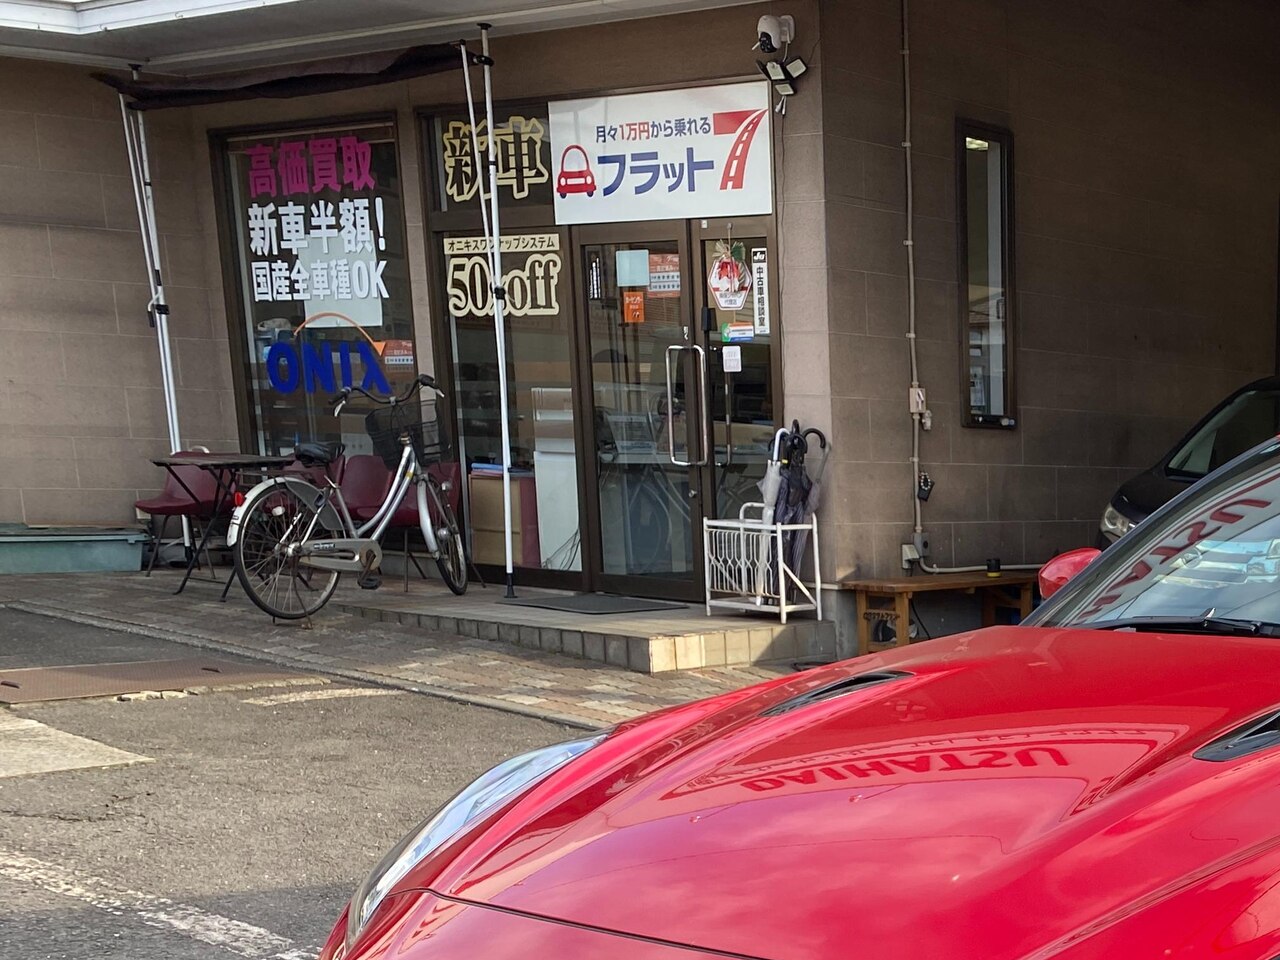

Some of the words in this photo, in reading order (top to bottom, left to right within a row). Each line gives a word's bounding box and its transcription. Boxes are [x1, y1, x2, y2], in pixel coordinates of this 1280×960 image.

[596, 118, 711, 143] 月々1万円から乗れる
[246, 137, 375, 198] 高価買取
[248, 197, 386, 256] 新車半額!
[250, 260, 390, 302] 国産全車種OK
[267, 340, 393, 395] ONIX
